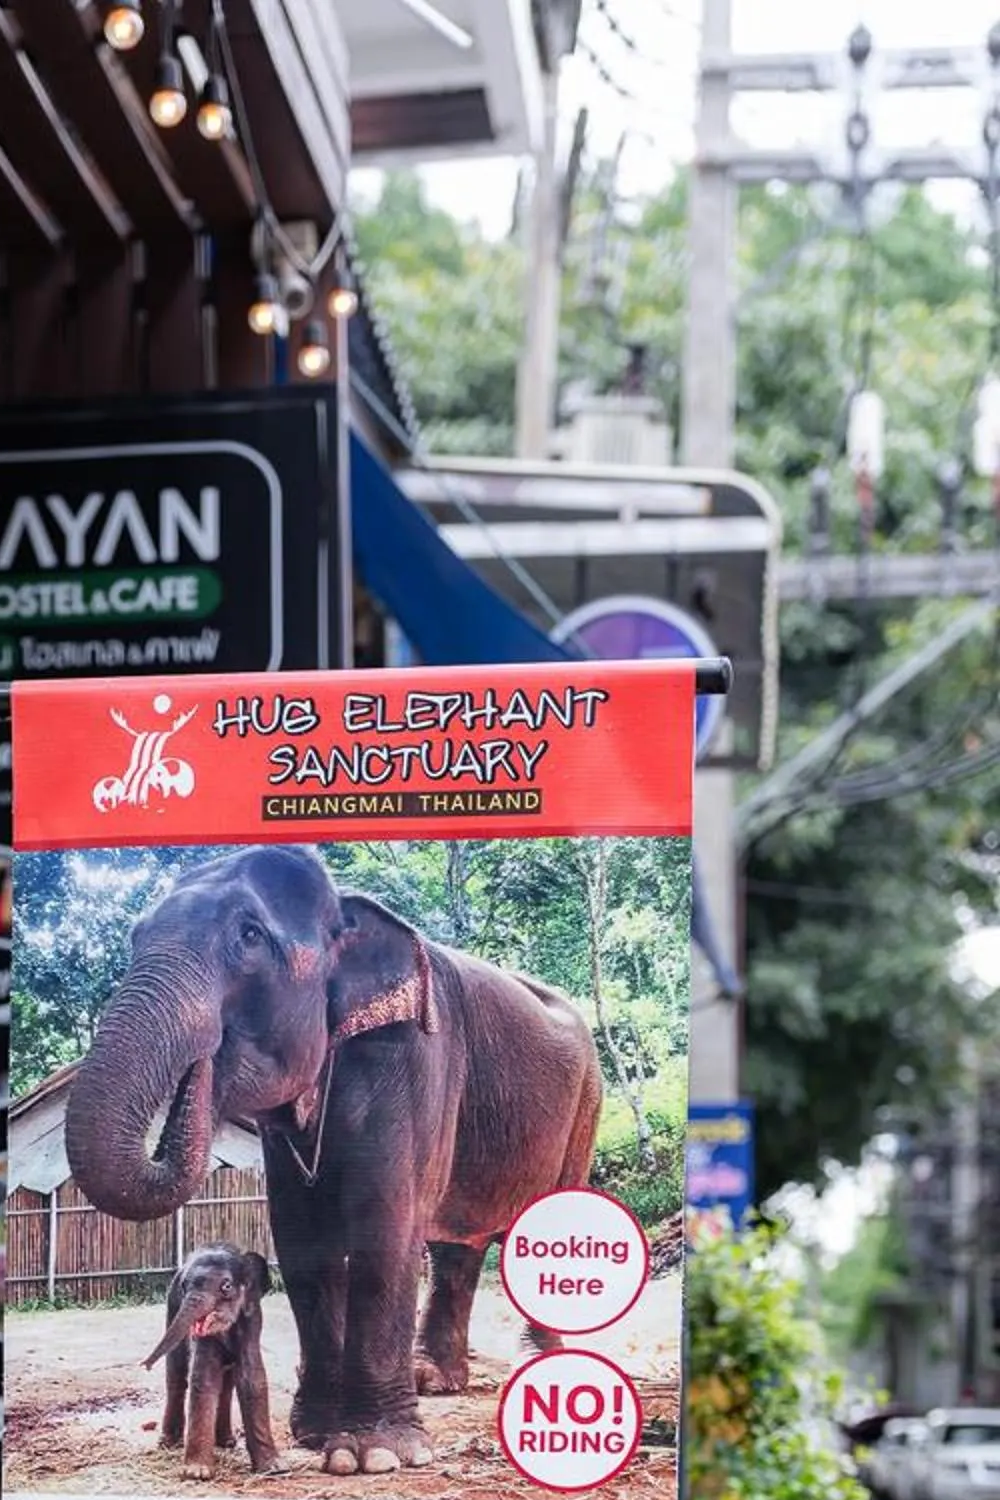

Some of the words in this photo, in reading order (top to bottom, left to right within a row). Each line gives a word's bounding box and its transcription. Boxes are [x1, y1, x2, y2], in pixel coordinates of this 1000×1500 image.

[212, 693, 321, 737] HUG
[342, 685, 610, 733] ELEPHANT
[267, 738, 549, 787] SANCTUARY
[266, 796, 403, 816] CHIANGMAI
[418, 791, 540, 812] THAILAND
[514, 1235, 630, 1265] Booking
[538, 1273, 605, 1296] Here
[523, 1383, 625, 1426] NO!
[518, 1430, 626, 1454] RIDING
